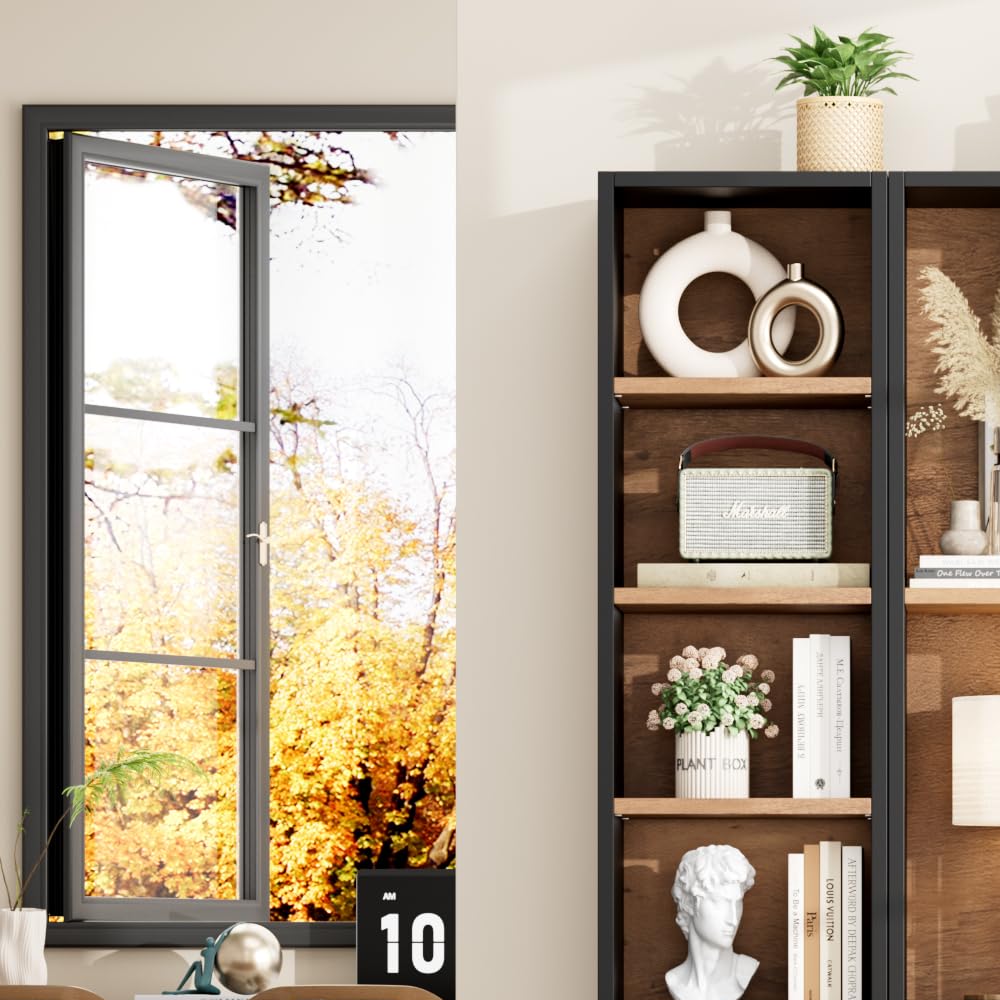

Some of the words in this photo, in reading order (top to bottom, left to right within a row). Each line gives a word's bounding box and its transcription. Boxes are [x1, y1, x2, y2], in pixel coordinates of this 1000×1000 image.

[721, 501, 791, 519] Marshall
[936, 569, 954, 578] One
[955, 569, 973, 578] Flew
[974, 569, 994, 578] Over
[676, 757, 717, 771] PLANT
[722, 757, 748, 771] BOX
[793, 888, 800, 897] To
[826, 878, 834, 903] LOUIS
[848, 858, 857, 913] AFTERWORD
[382, 892, 397, 901] AM
[793, 899, 800, 910] Be
[806, 912, 817, 938] Paris
[826, 905, 834, 942] VUITTON
[848, 916, 857, 926] BY
[380, 912, 445, 974] 10
[848, 929, 857, 962] DEEPAK
[848, 965, 857, 1000] CHOPRA
